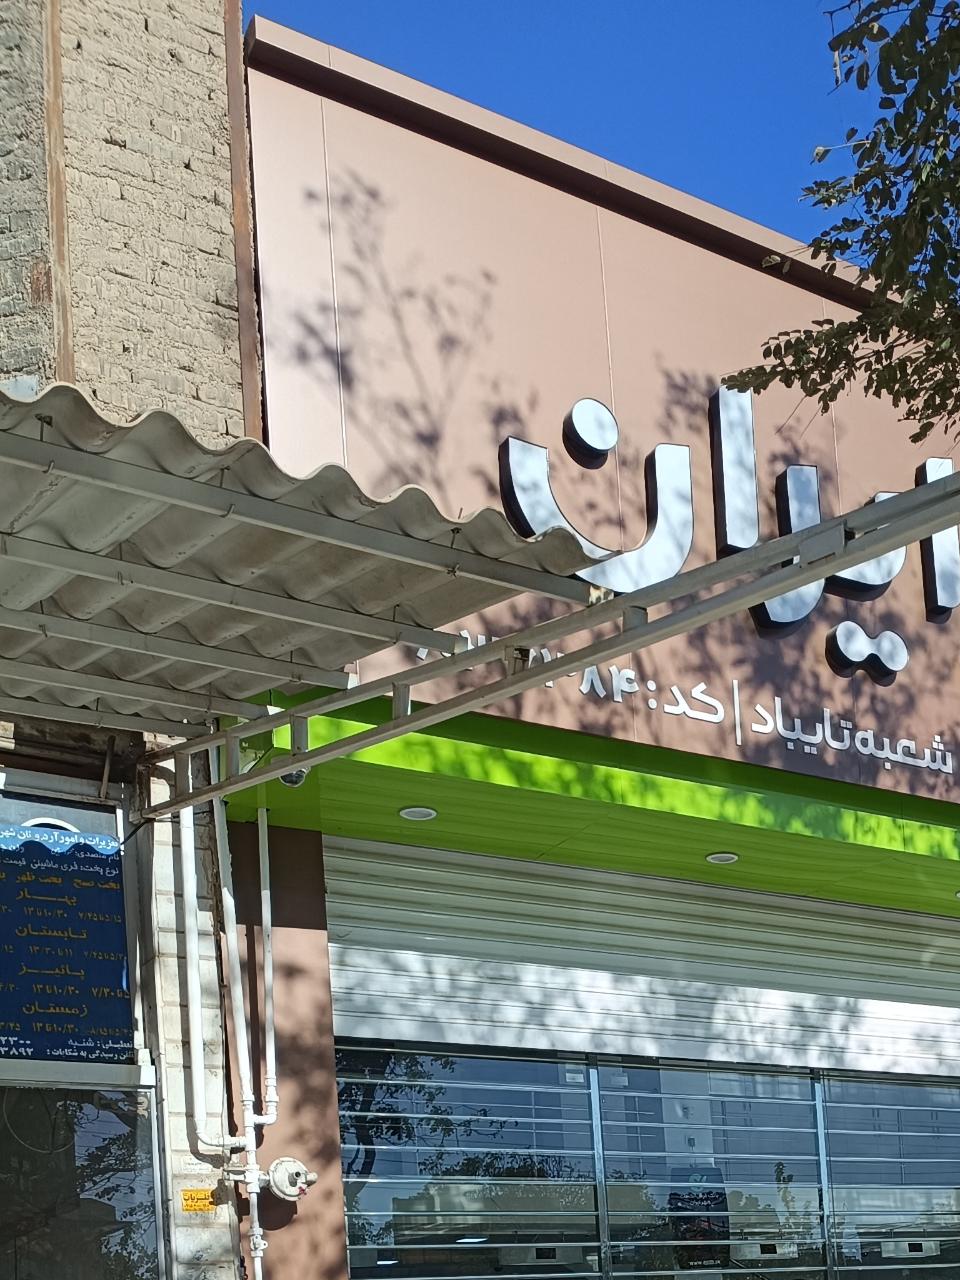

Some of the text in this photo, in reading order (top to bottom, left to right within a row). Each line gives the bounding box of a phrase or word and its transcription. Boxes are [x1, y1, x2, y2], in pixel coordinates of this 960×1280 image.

[751, 696, 853, 755] تایباد
[856, 729, 953, 775] شعبه
[17, 830, 32, 839] نان
[60, 834, 78, 844] امور
